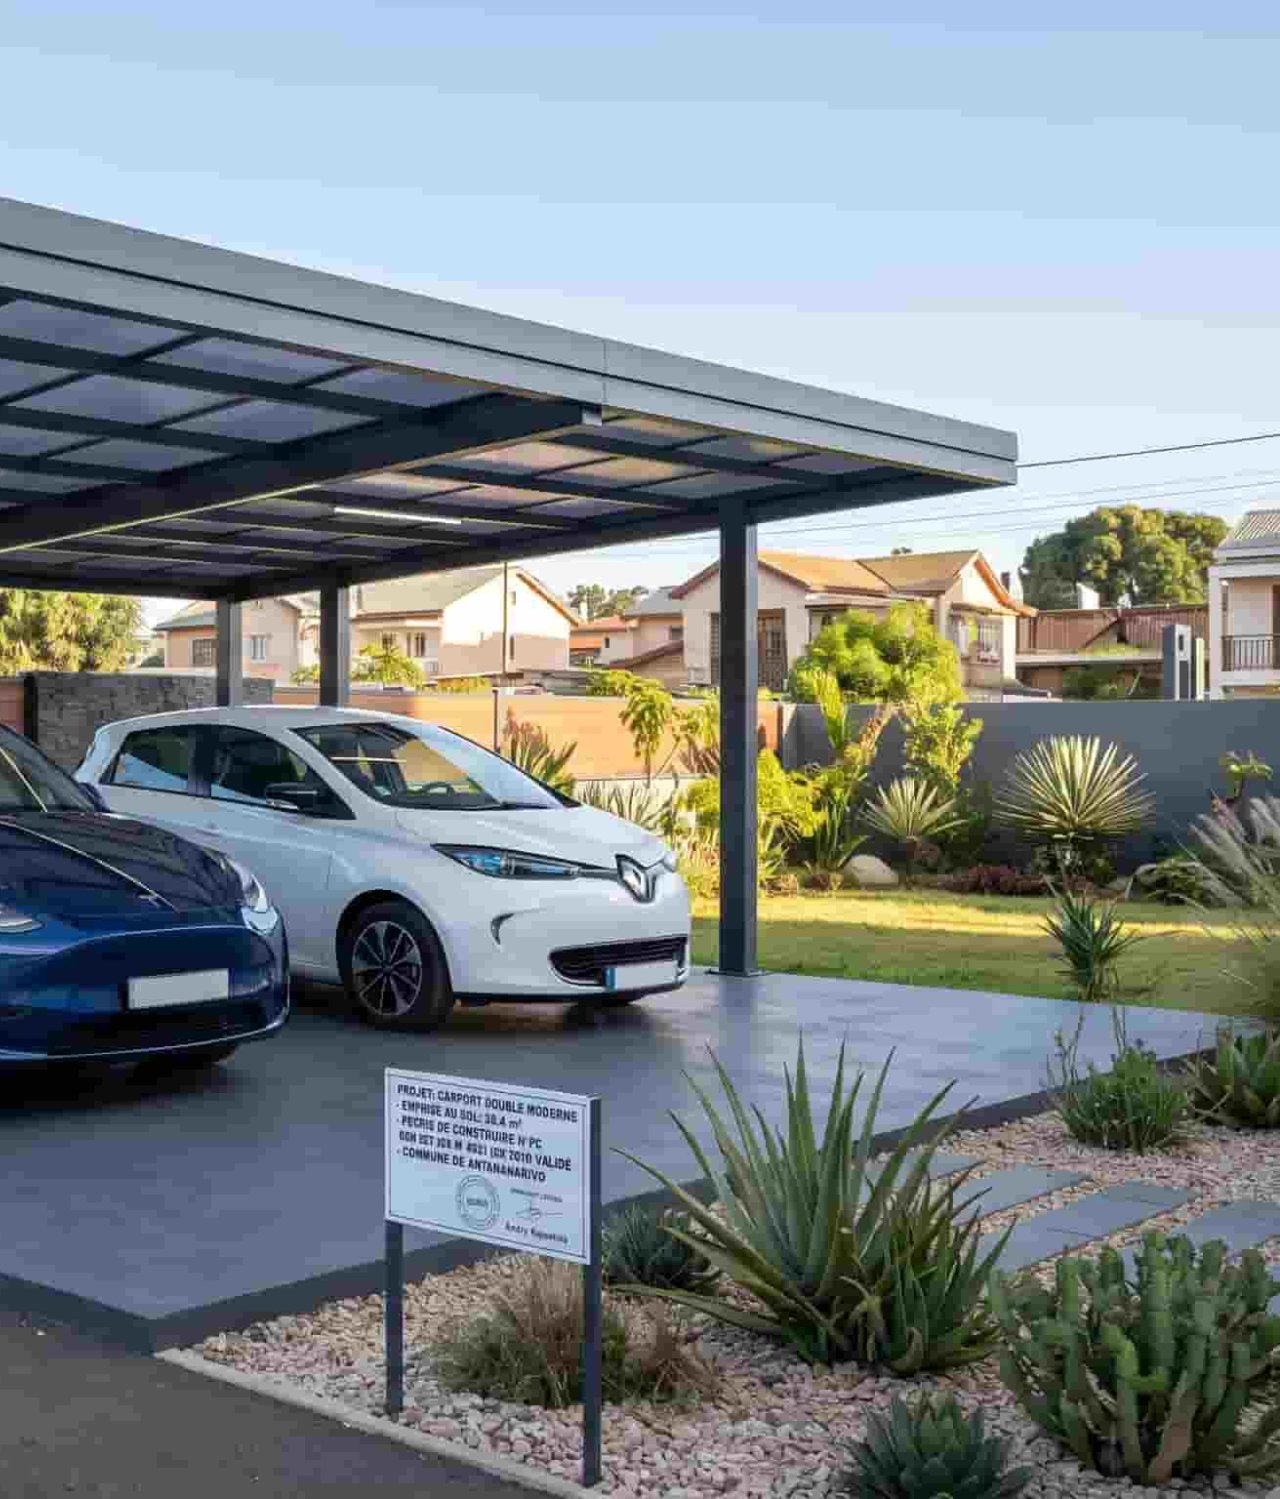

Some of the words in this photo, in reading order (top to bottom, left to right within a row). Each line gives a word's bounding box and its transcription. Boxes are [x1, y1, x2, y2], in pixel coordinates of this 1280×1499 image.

[398, 1084, 435, 1100] PROJET:
[438, 1091, 482, 1106] CARPORT
[485, 1098, 524, 1114] DOUBLE
[527, 1104, 578, 1122] MODERNE
[444, 1108, 458, 1118] AU
[438, 1121, 450, 1132] DE
[453, 1124, 515, 1145] CONSTRUIRE
[529, 1136, 542, 1148] PC
[403, 1147, 450, 1164] COMMUNE
[453, 1154, 465, 1167] DE
[468, 1158, 546, 1182] ANTANANARIVO
